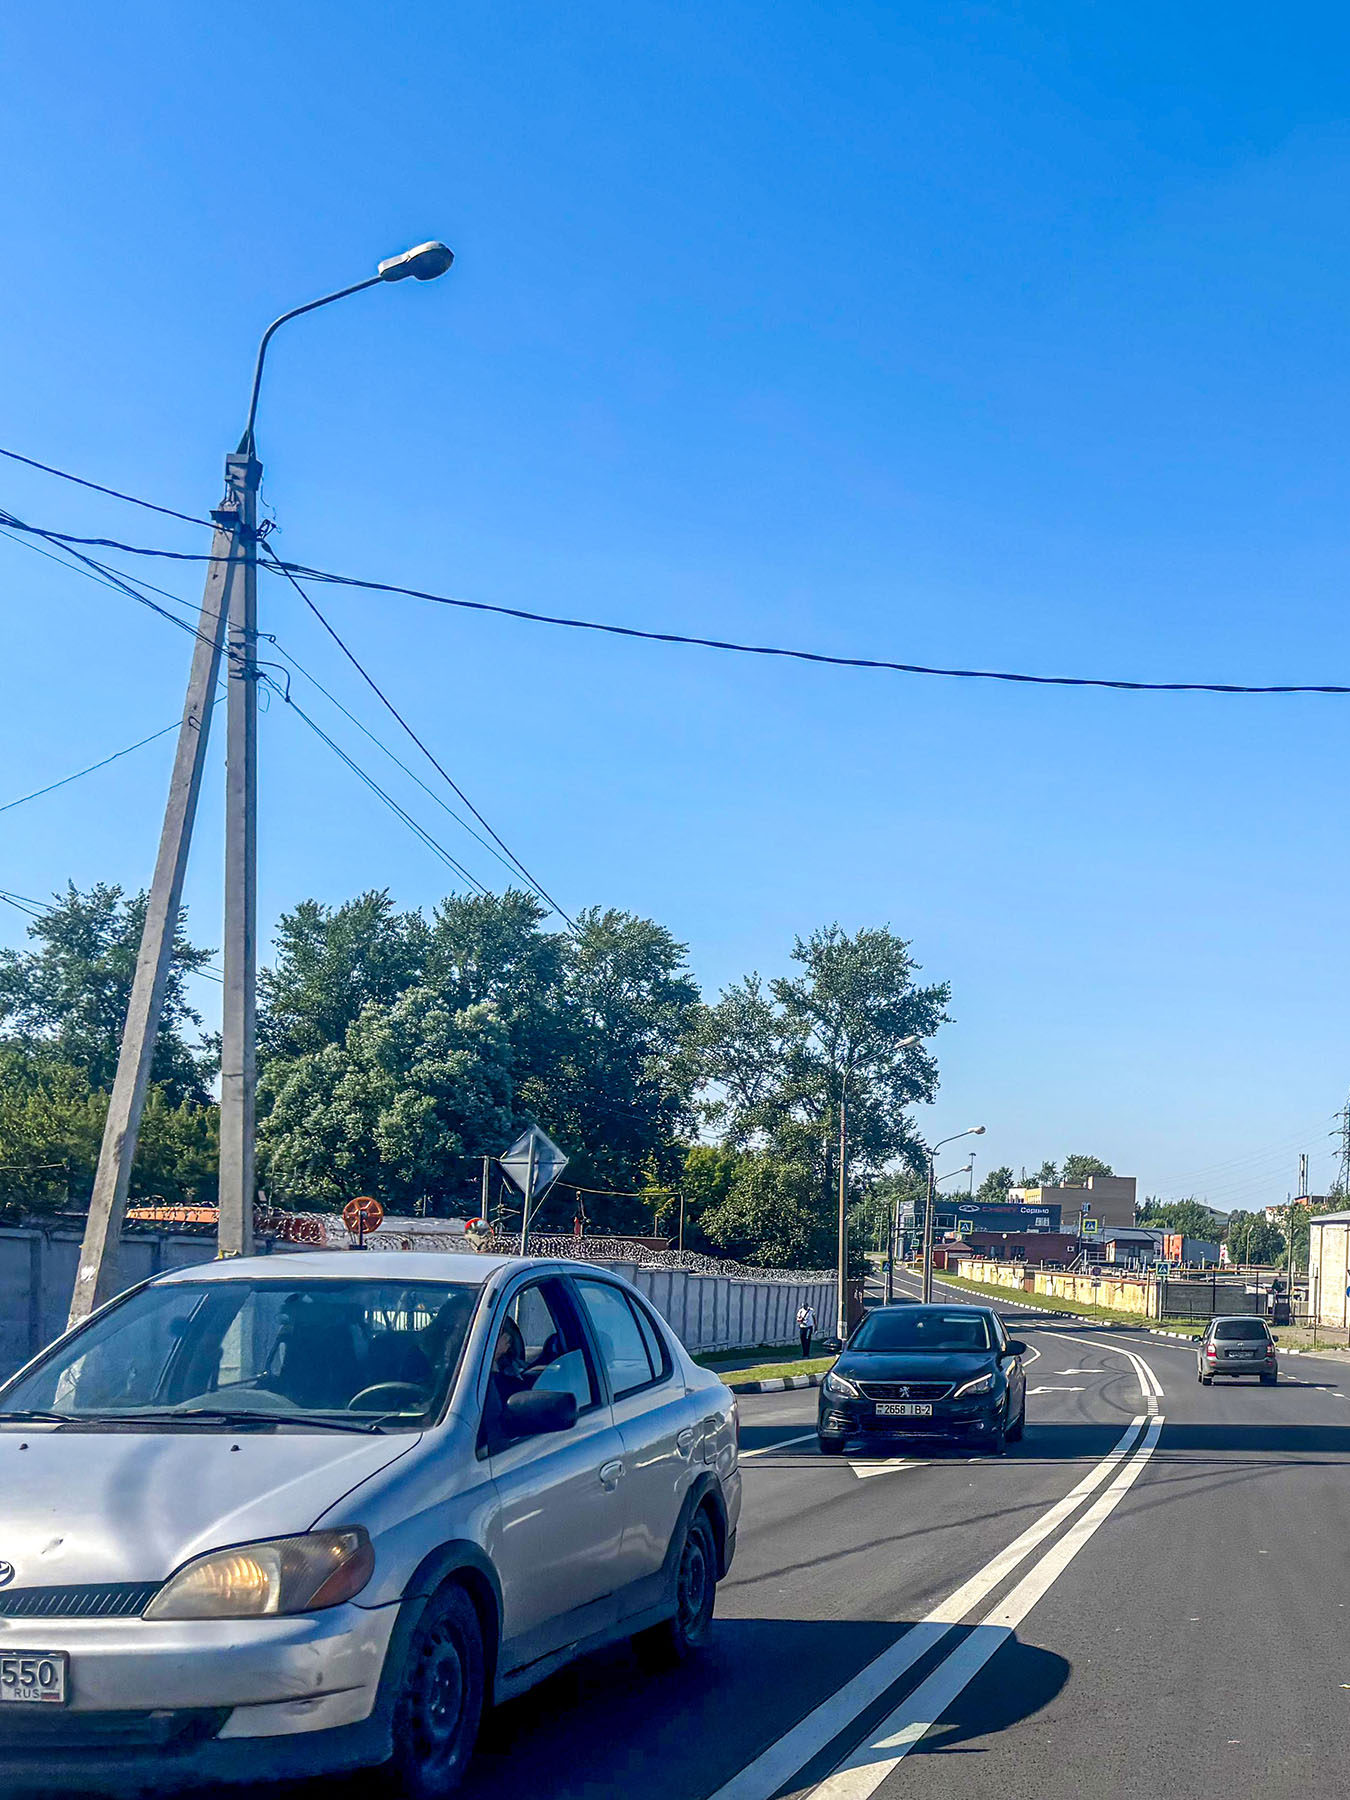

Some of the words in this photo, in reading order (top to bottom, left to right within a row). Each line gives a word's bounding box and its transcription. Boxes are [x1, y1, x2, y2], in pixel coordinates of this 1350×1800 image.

[884, 1404, 906, 1415] 2658
[1, 1658, 53, 1687] 550
[14, 1688, 41, 1699] RUS
